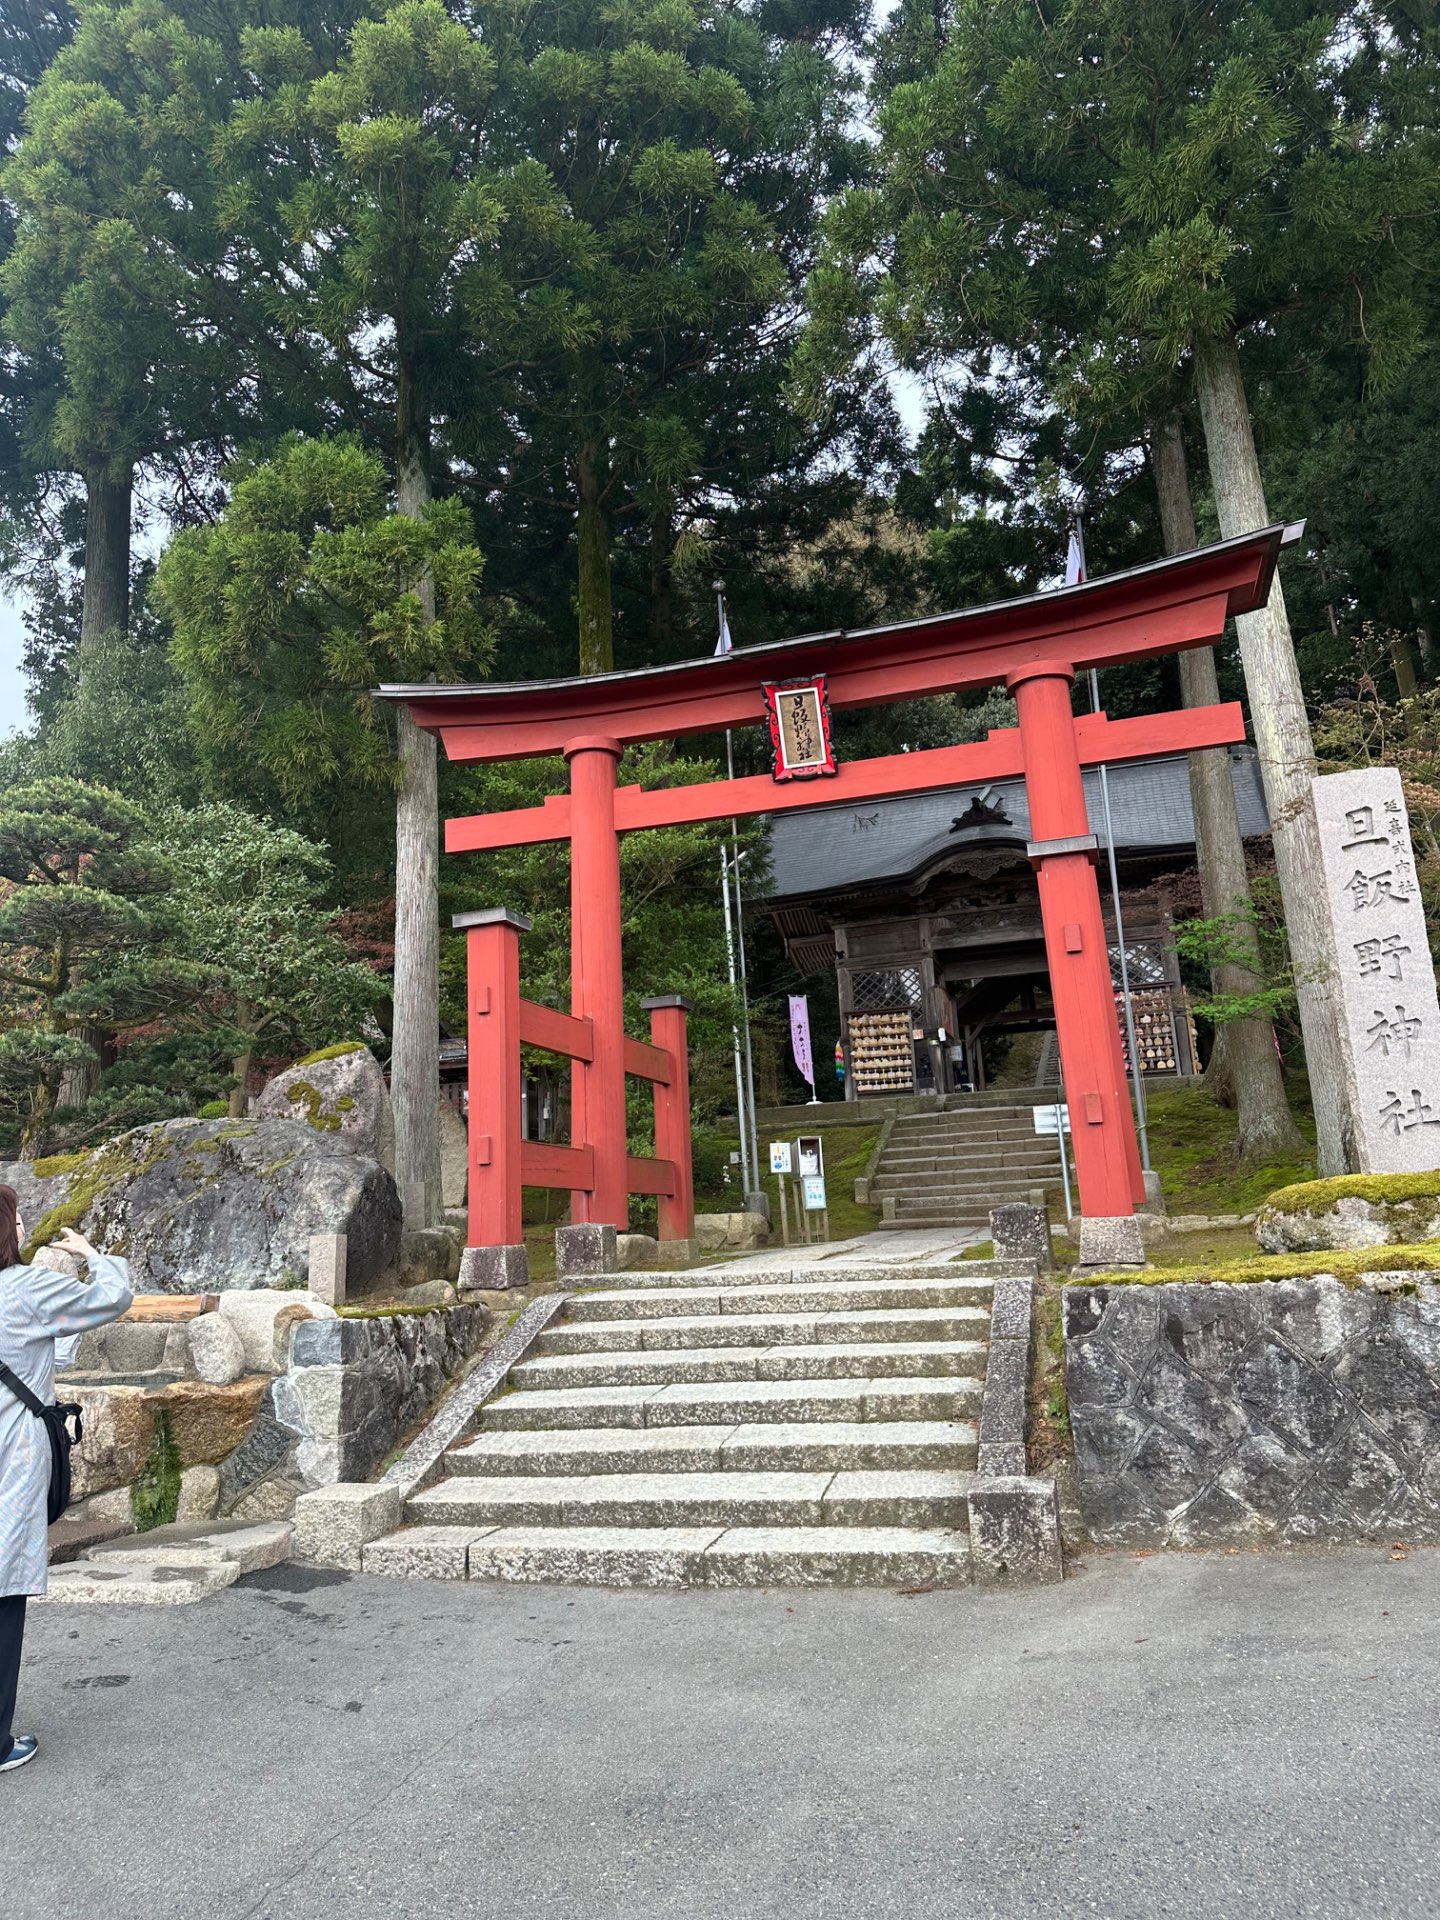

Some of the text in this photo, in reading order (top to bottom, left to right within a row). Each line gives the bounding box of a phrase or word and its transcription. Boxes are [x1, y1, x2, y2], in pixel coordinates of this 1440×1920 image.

[1341, 805, 1440, 1136] 旦飯野神社
